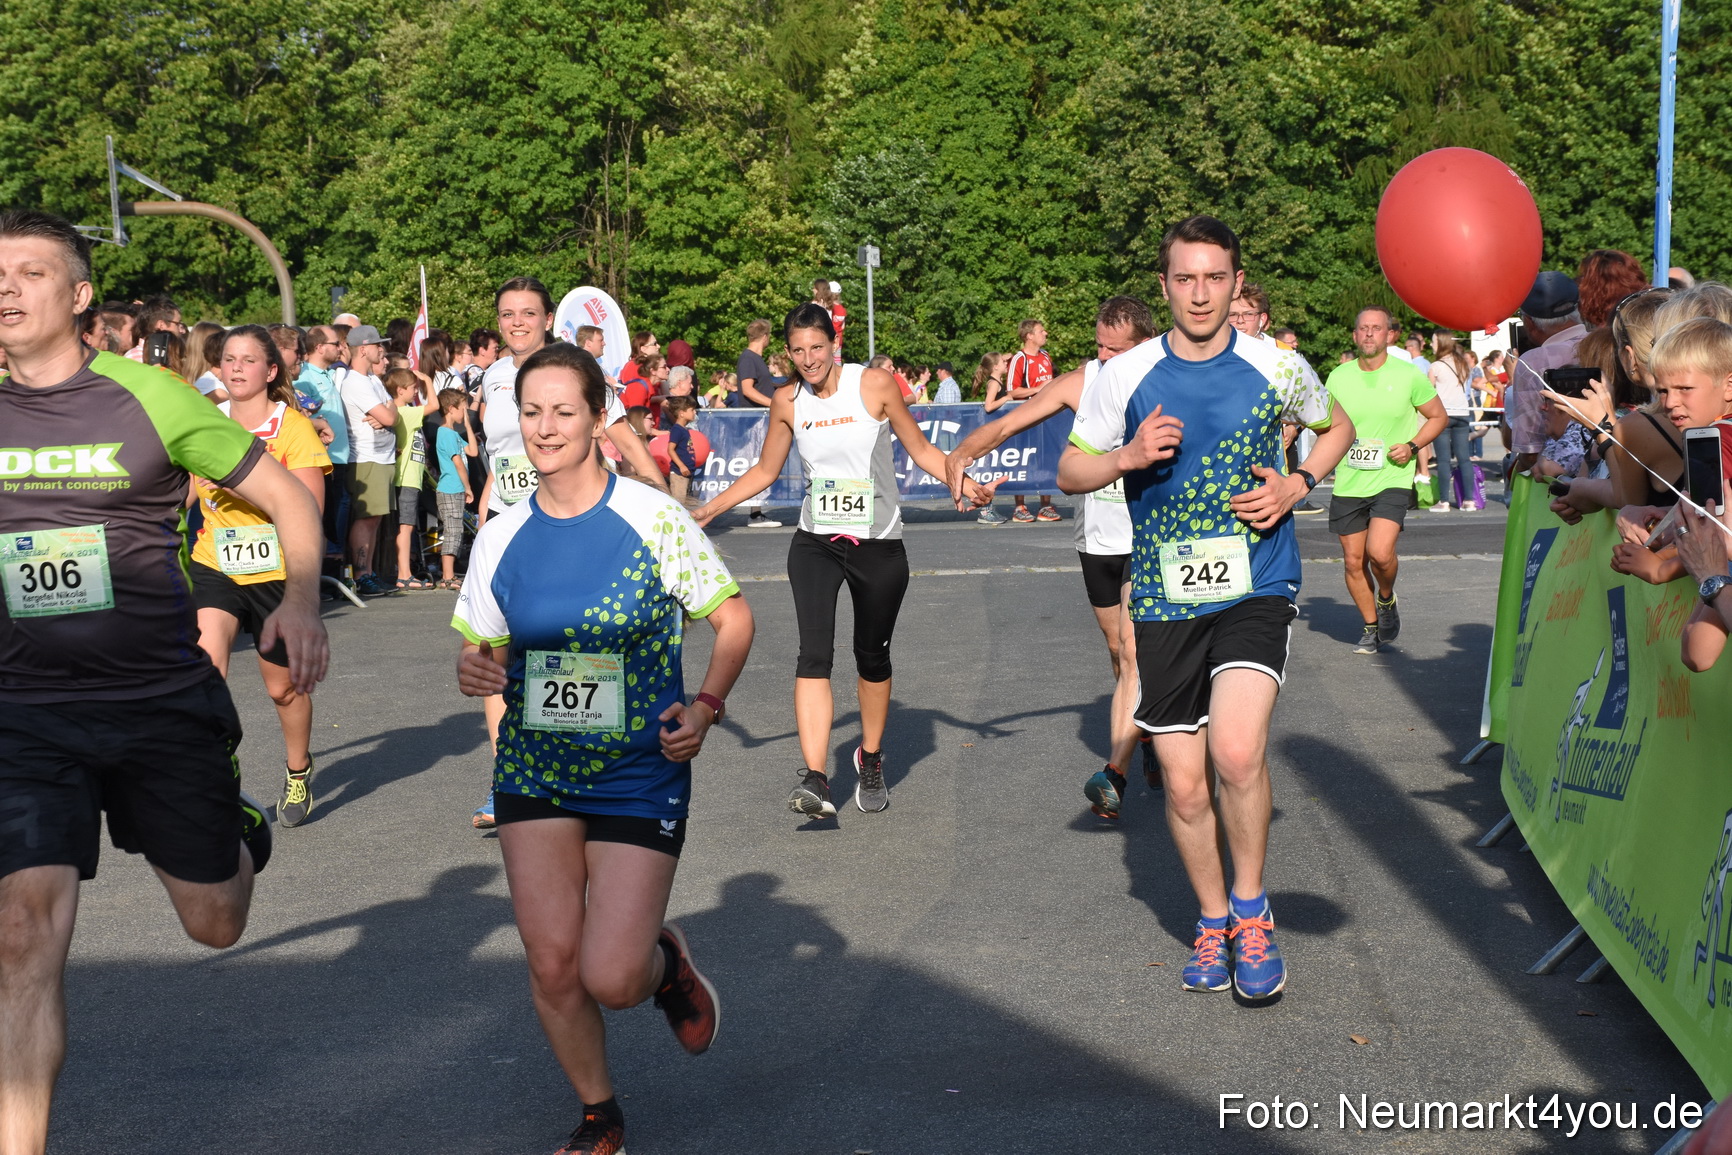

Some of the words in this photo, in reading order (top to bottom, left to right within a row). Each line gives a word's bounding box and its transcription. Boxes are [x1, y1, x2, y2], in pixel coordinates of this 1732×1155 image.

[815, 416, 858, 428] KLEBL
[1350, 449, 1379, 461] 2027
[3, 480, 20, 493] by
[23, 480, 63, 491] smart
[66, 479, 131, 492] concepts
[500, 470, 539, 490] 1183
[819, 494, 866, 512] 1154
[222, 541, 270, 562] 1710
[19, 559, 82, 593] 306
[1179, 560, 1231, 586] 242
[56, 589, 88, 600] Nikolai
[542, 680, 599, 710] 267
[541, 709, 578, 719] Schruefer
[579, 711, 603, 720] Tanja
